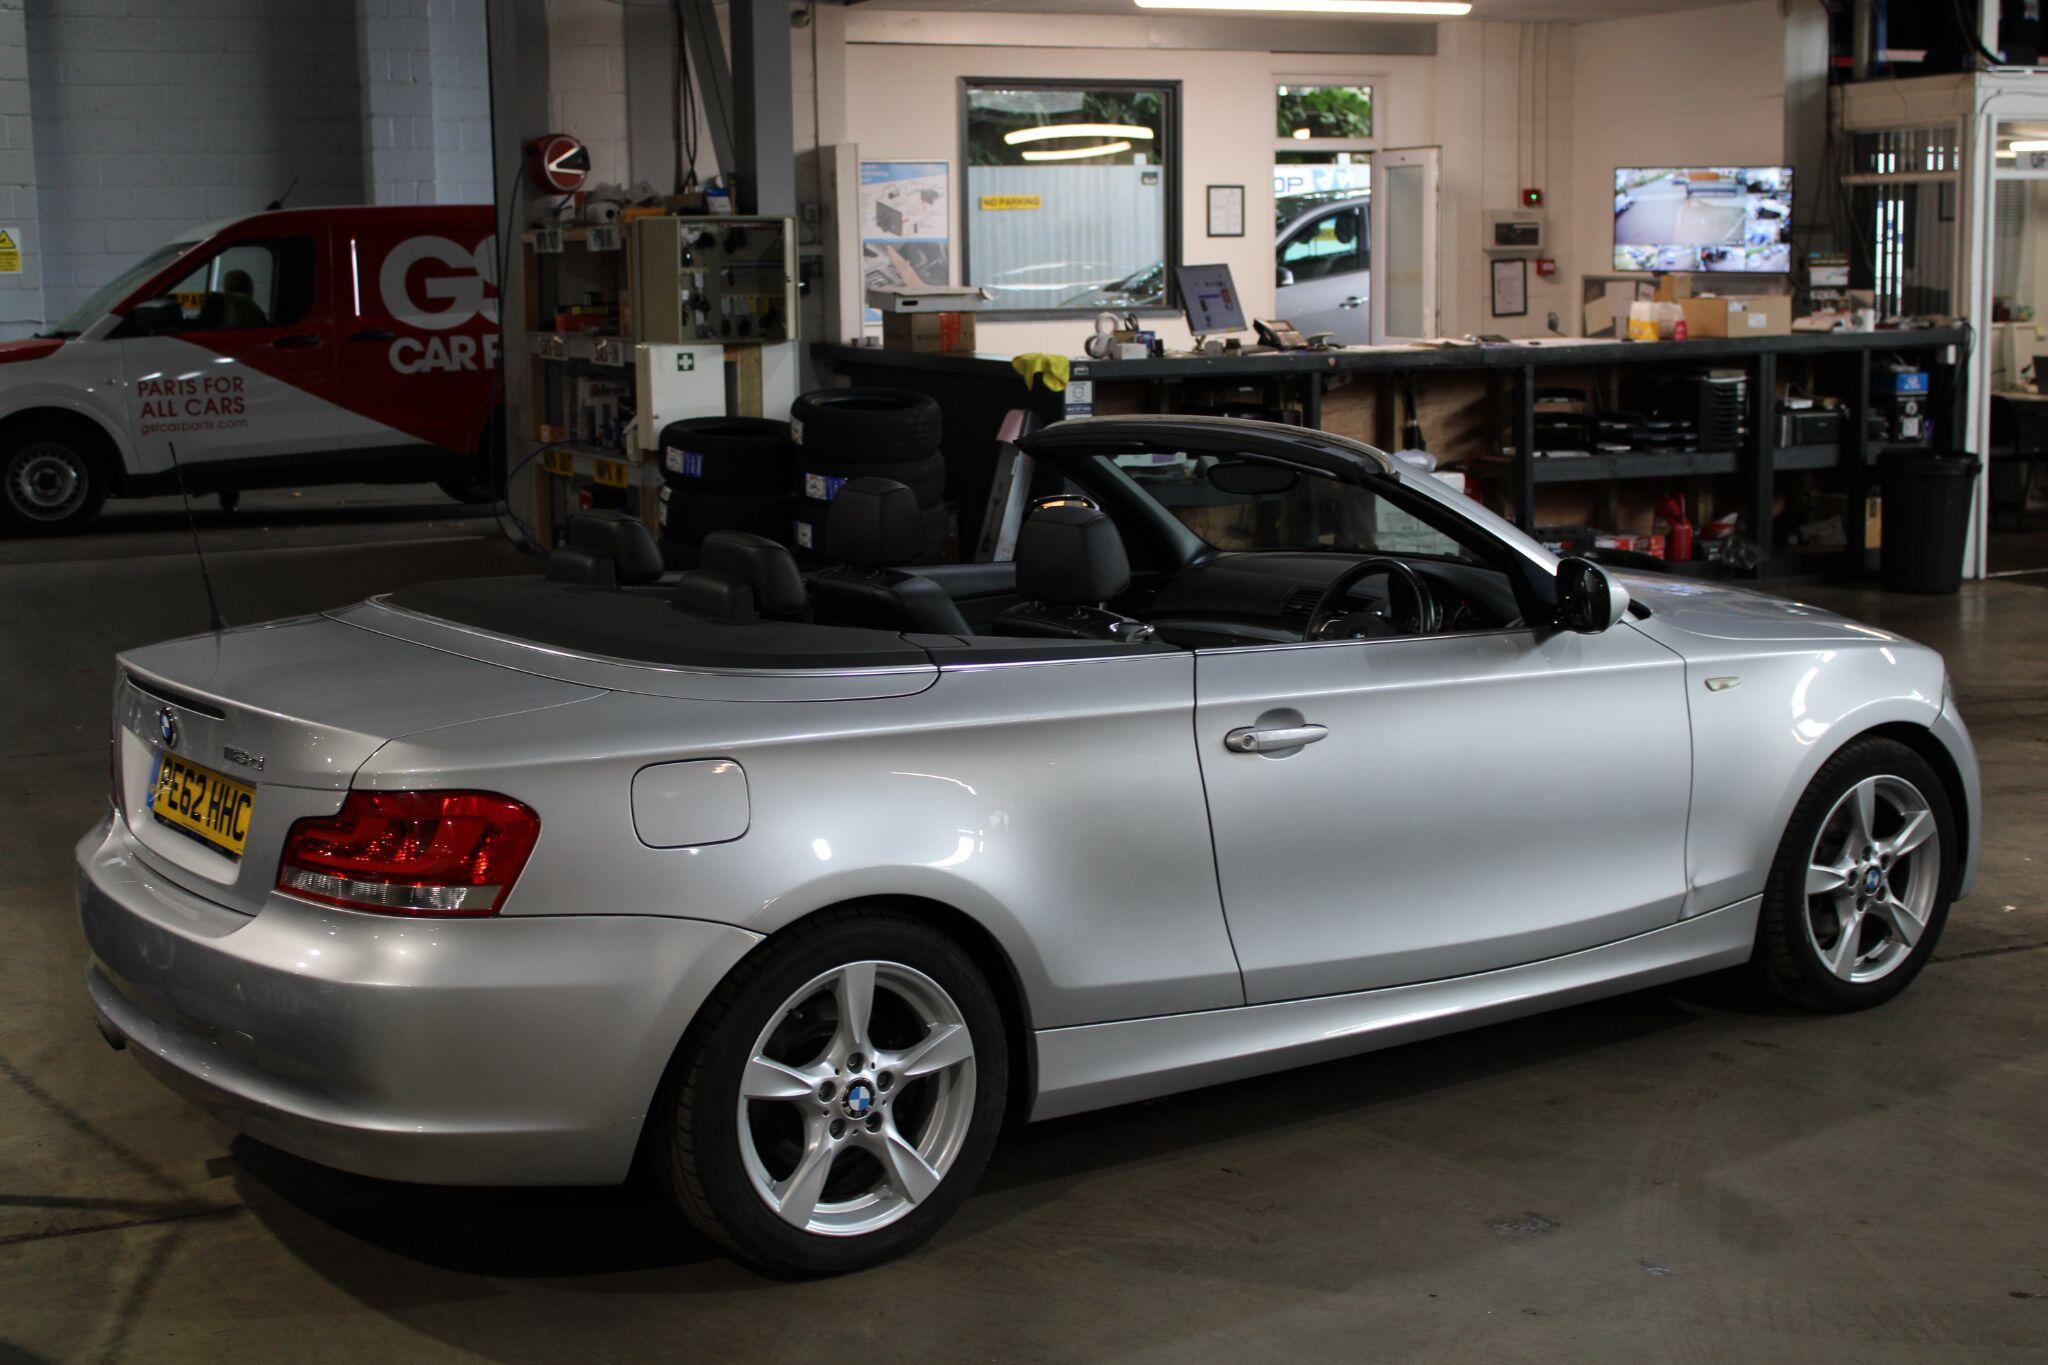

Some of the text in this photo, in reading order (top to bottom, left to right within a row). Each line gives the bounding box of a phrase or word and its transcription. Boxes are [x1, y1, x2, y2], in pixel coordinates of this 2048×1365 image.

[984, 198, 1040, 207] NO PARKING
[388, 334, 479, 374] CAR
[137, 377, 244, 397] PARTS FOR
[140, 396, 245, 418] ALL CARS
[157, 757, 251, 841] PE62 HHC
